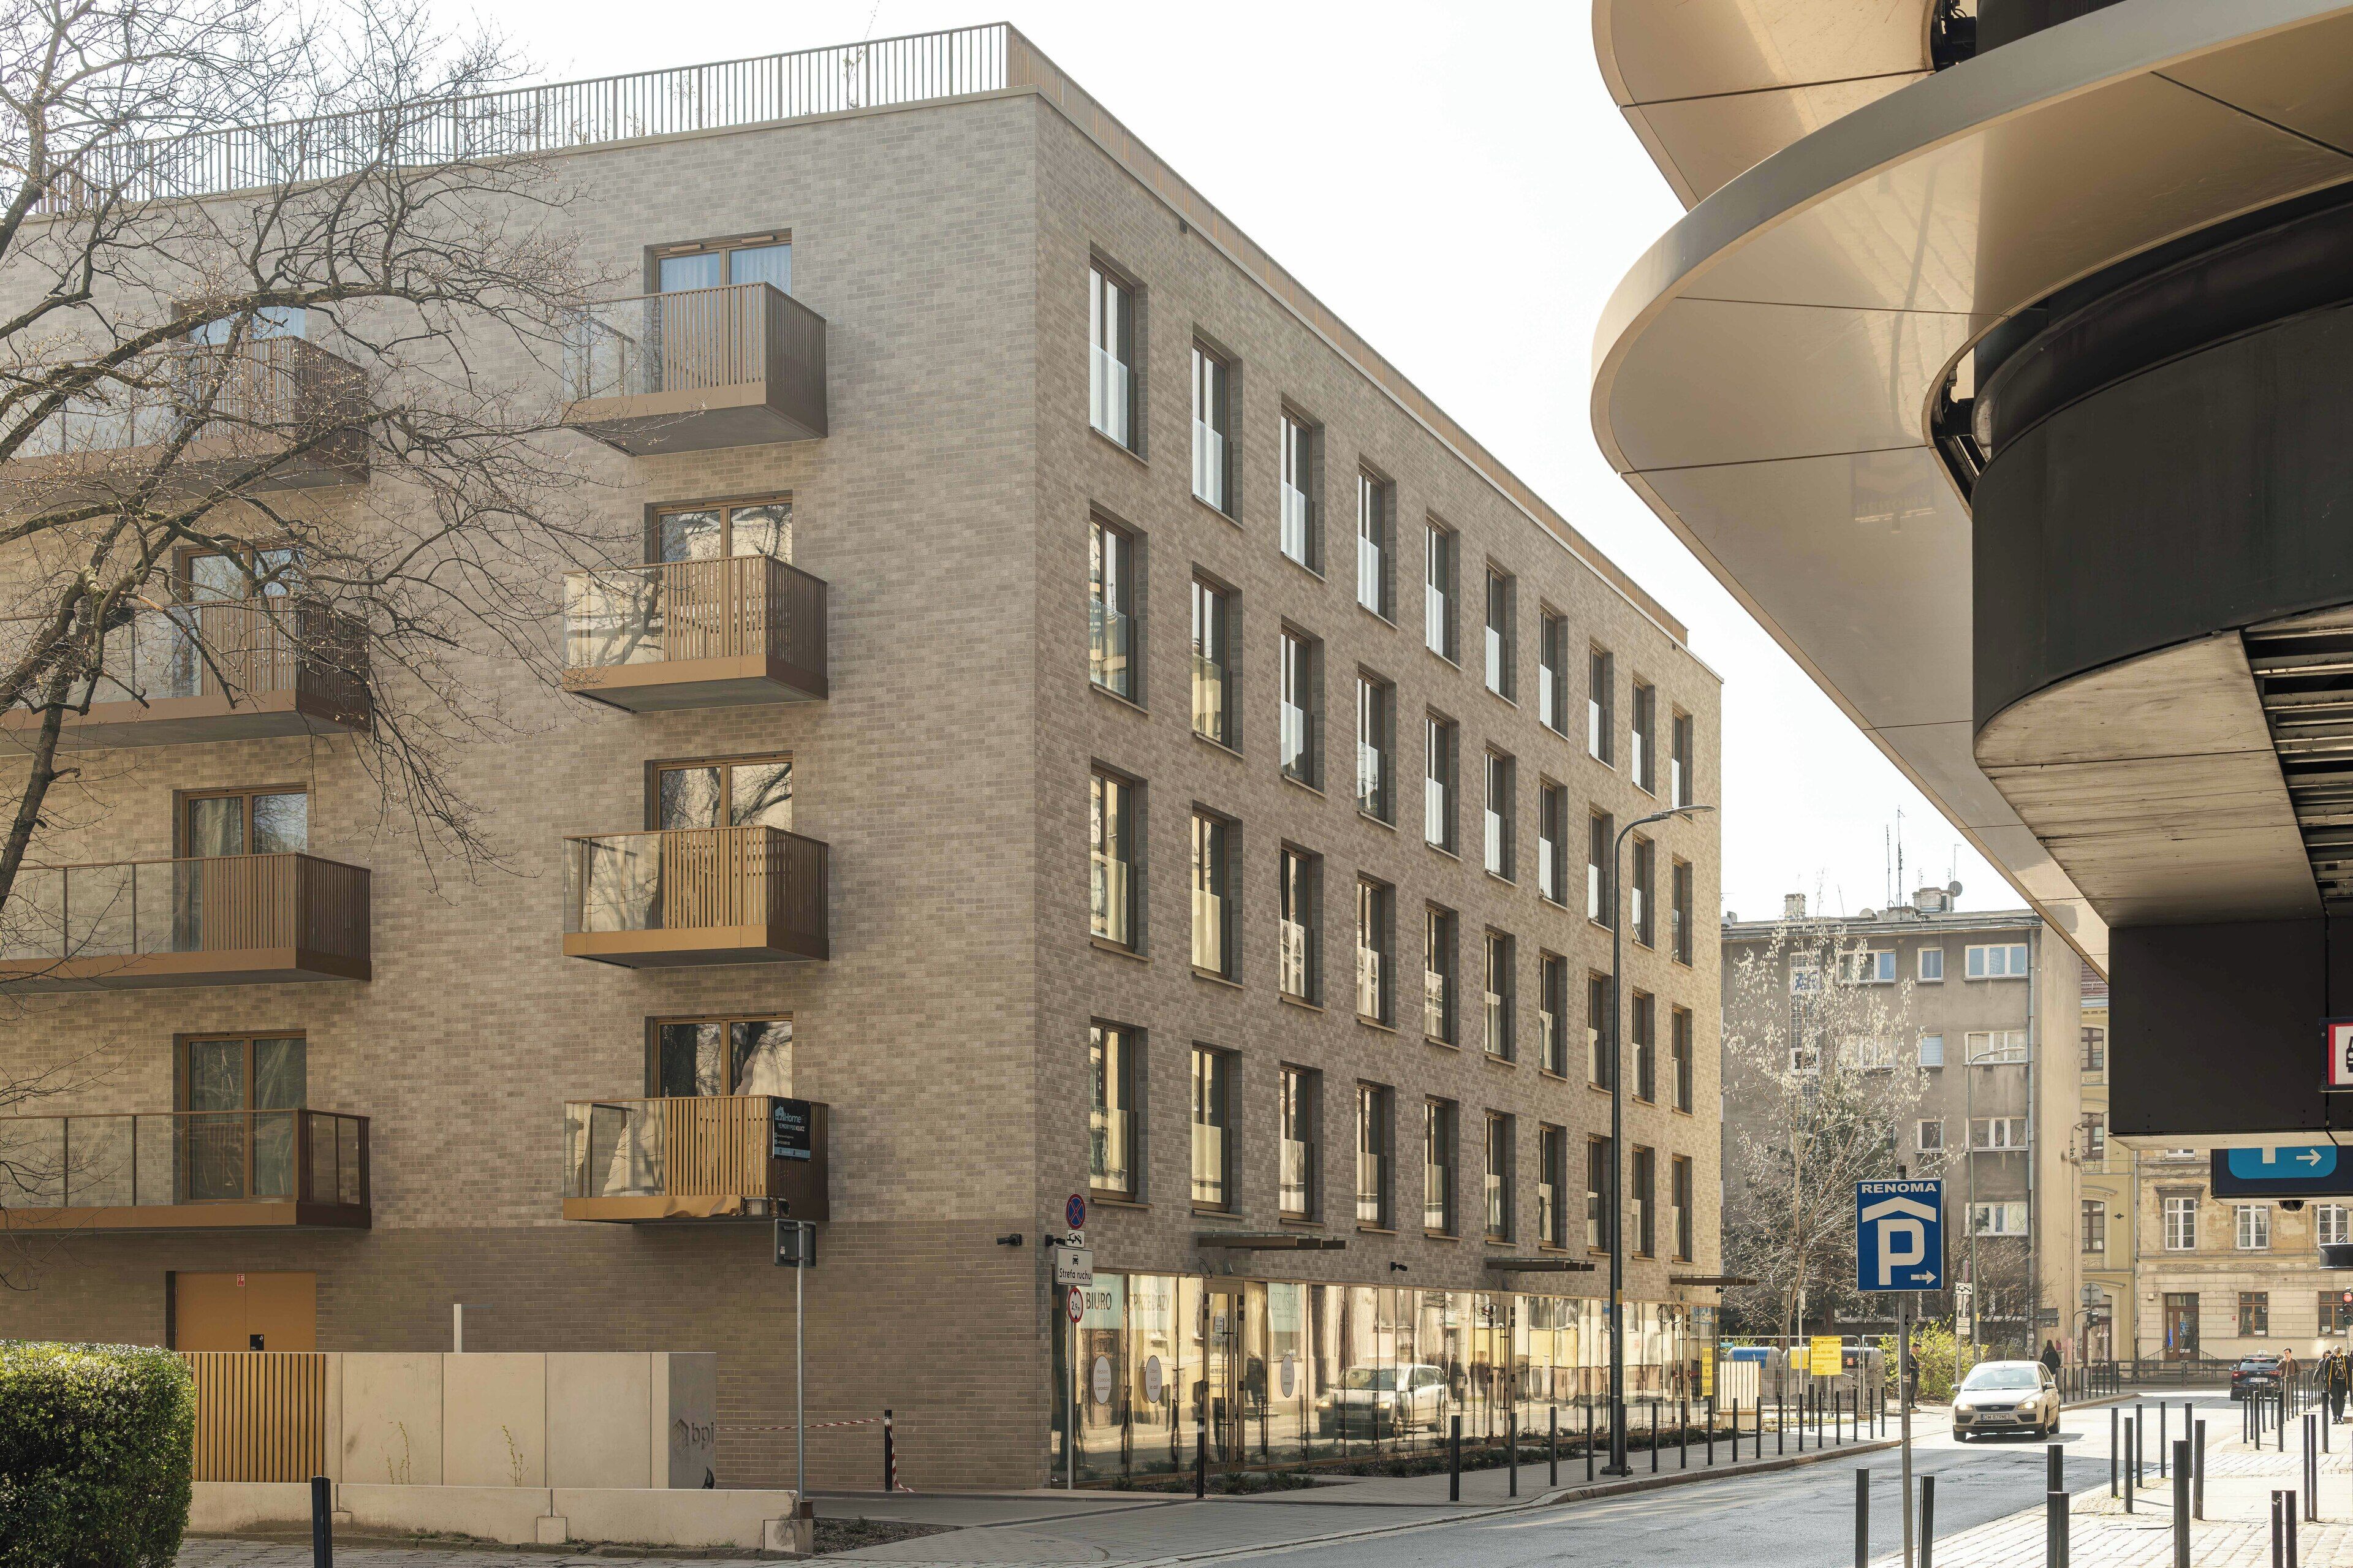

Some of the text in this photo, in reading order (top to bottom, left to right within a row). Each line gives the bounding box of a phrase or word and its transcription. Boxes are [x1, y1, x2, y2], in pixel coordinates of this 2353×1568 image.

[785, 1113, 801, 1123] Home
[1862, 1183, 1937, 1194] RENOMA
[1877, 1219, 1925, 1286] P
[1059, 1268, 1091, 1280] Strefa ruchu
[1086, 1292, 1112, 1310] BIURO
[691, 1422, 714, 1450] bpi
